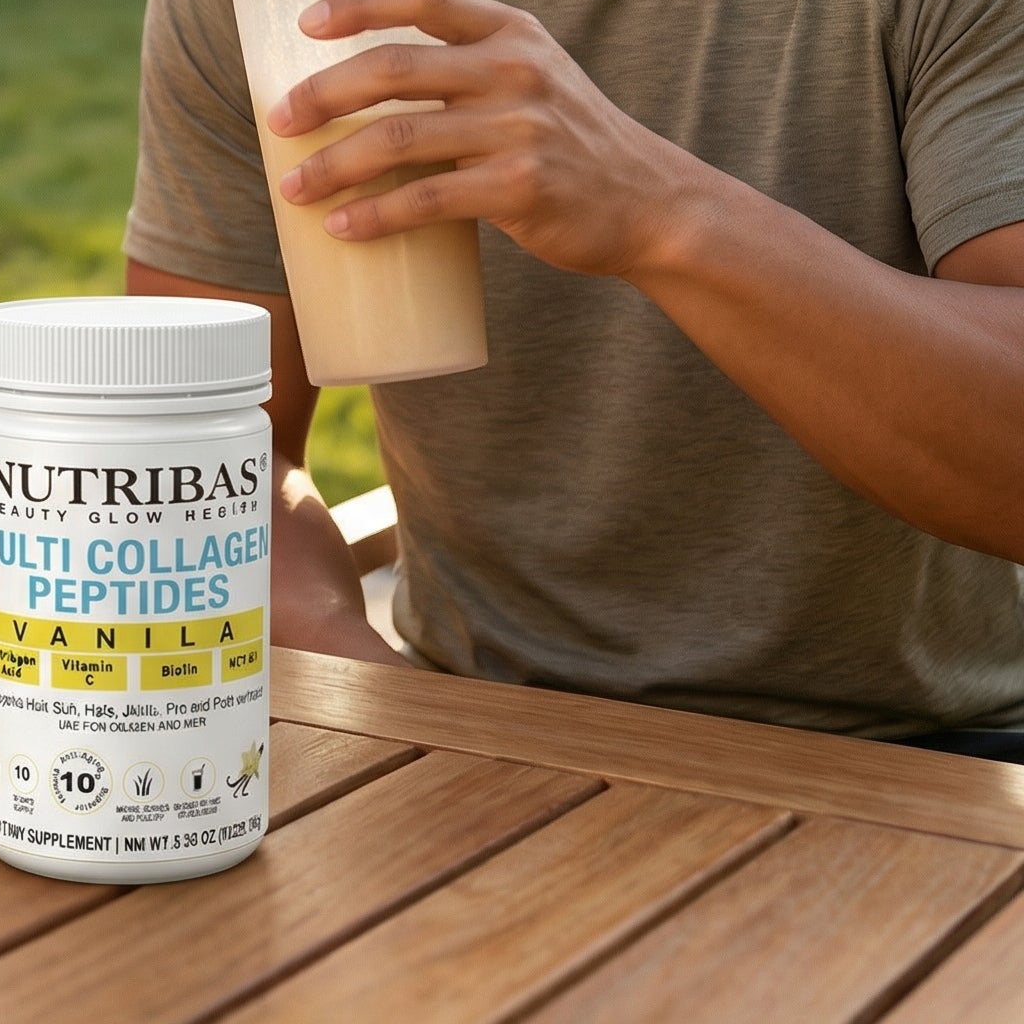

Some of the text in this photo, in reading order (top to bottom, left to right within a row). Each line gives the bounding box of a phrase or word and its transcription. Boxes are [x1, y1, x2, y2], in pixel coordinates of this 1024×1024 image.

[88, 511, 163, 524] GLOW
[87, 523, 269, 576] COLLAGEN
[28, 574, 230, 615] PEPTIDES
[12, 620, 235, 649] VANILA
[62, 658, 114, 673] Vitamin
[85, 674, 95, 686] C
[15, 765, 31, 782] 10
[60, 771, 96, 794] 10
[27, 828, 113, 852] SUPPLEMENT
